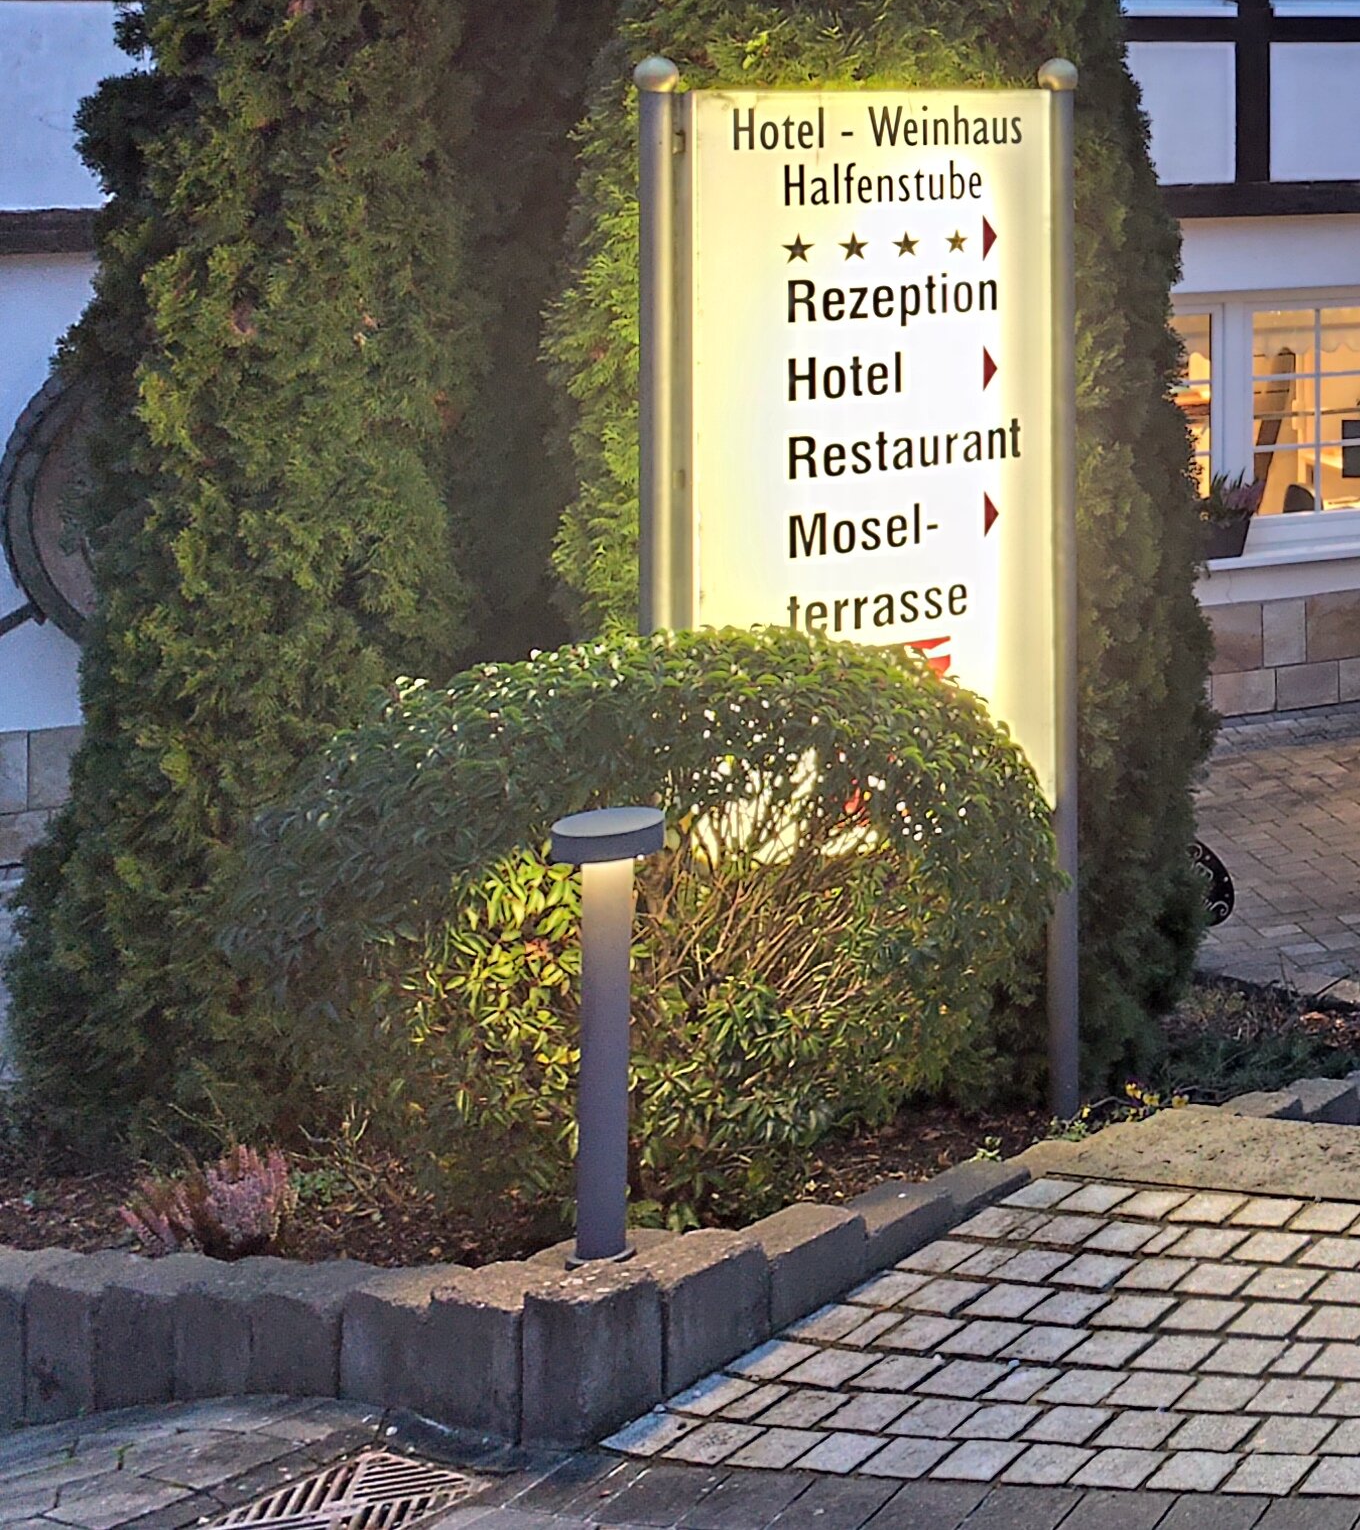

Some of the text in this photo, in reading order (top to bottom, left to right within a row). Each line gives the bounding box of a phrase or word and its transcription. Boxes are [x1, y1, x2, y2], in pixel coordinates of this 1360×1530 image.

[733, 107, 826, 151] Hotel
[868, 105, 1023, 148] Weinhaus
[783, 160, 983, 207] Halfenstube
[787, 272, 998, 327] Rezeption
[788, 351, 903, 402] Hotel
[788, 418, 1022, 480] Restaurant
[789, 503, 939, 559] Mosel-
[787, 584, 967, 636] terrasse
